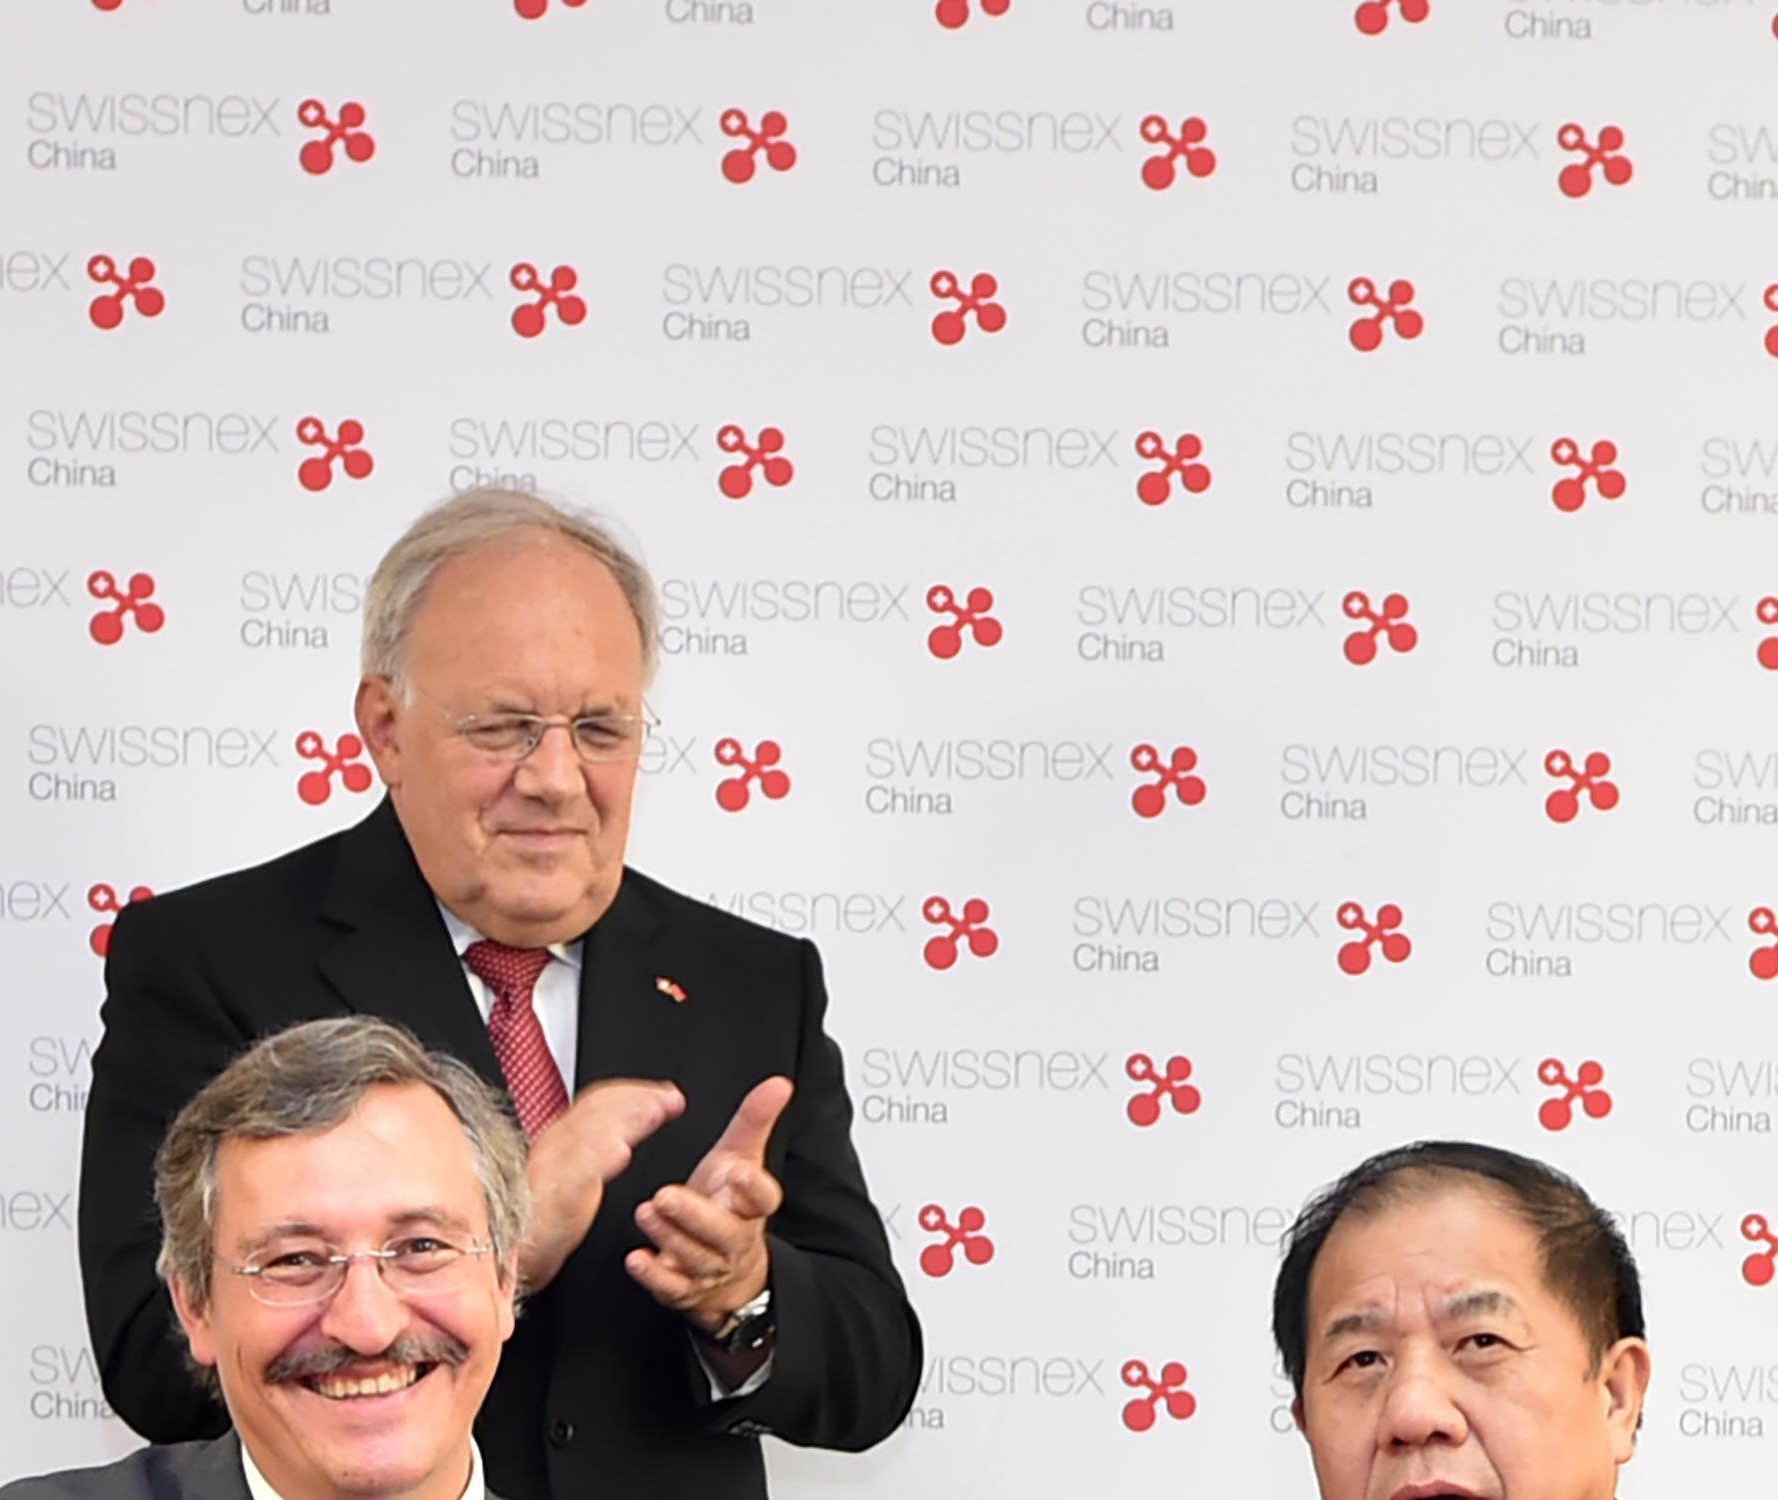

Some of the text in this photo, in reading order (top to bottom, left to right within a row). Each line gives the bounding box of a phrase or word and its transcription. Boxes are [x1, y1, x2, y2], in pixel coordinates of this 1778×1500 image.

[1086, 0, 1175, 31] China
[1504, 9, 1592, 40] China
[28, 91, 279, 136] swissnex
[452, 100, 702, 145] swissnex
[873, 108, 1123, 153] swissnex
[1293, 116, 1541, 160] swissnex
[27, 139, 117, 171] China
[451, 147, 540, 179] China
[872, 156, 960, 188] China
[1291, 163, 1378, 194] China
[240, 255, 490, 299] swissnex
[662, 263, 911, 307] swissnex
[1081, 271, 1329, 314] swissnex
[1498, 277, 1745, 320] swissnex
[241, 302, 329, 333] China
[662, 311, 751, 342] China
[1081, 318, 1169, 348] China
[1498, 324, 1585, 355] China
[29, 409, 279, 454] swissnex
[450, 417, 700, 461] swissnex
[870, 425, 1118, 468] swissnex
[1288, 431, 1534, 474] swissnex
[27, 456, 116, 487] China
[868, 472, 956, 503] China
[1286, 478, 1373, 508] China
[659, 578, 908, 621] swissnex
[1077, 585, 1324, 628] swissnex
[1492, 591, 1738, 633] swissnex
[240, 618, 329, 649] China
[659, 626, 748, 656] China
[1077, 632, 1164, 662] China
[1492, 638, 1579, 668] China
[30, 724, 279, 768] swissnex
[867, 738, 1114, 780] swissnex
[1282, 744, 1528, 786] swissnex
[28, 771, 117, 802] China
[865, 785, 953, 815] China
[1280, 790, 1367, 820] China
[1693, 796, 1778, 826] China
[1072, 896, 1318, 938] swissnex
[1486, 901, 1730, 943] swissnex
[1073, 942, 1159, 973] China
[1485, 947, 1572, 978] China
[863, 1048, 1109, 1089] swissnex
[1277, 1053, 1521, 1094] swissnex
[862, 1094, 948, 1124] China
[1274, 1099, 1361, 1129] China
[1686, 1104, 1771, 1133] China
[1068, 1250, 1155, 1280] China
[1679, 1408, 1763, 1438] China
